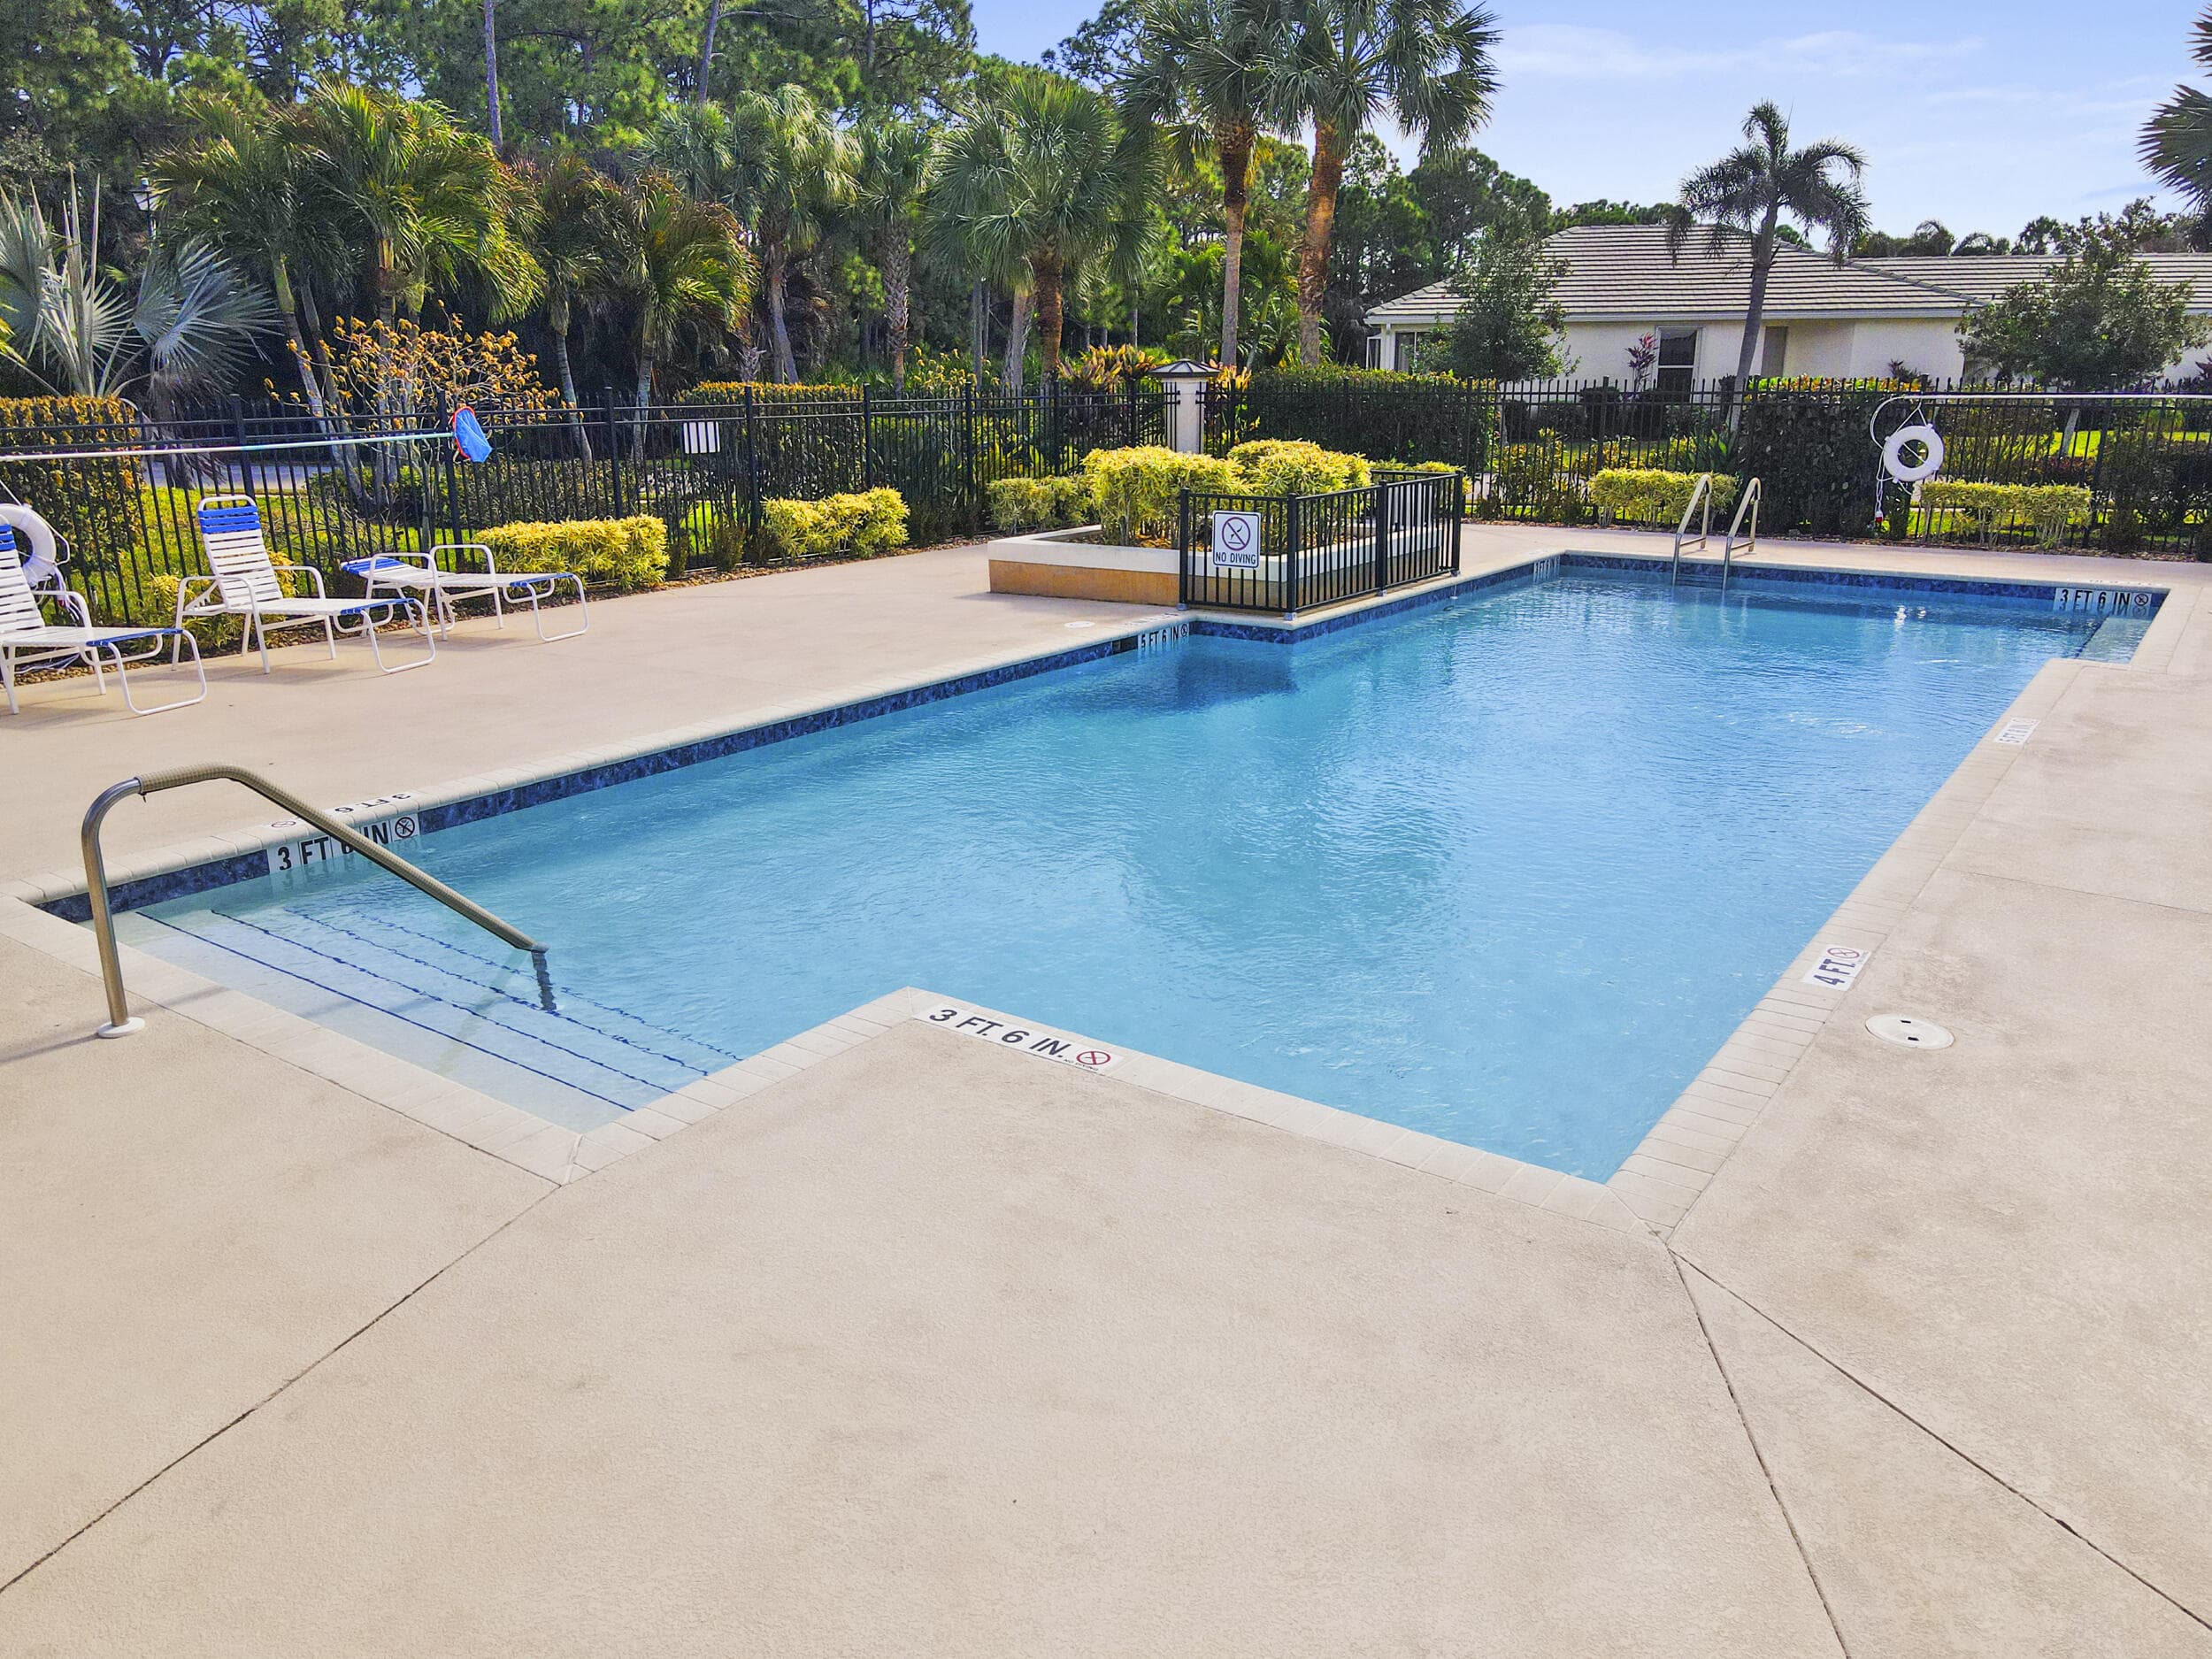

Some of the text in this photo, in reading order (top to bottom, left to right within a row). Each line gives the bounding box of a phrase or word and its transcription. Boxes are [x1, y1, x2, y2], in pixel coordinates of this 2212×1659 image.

[1216, 552, 1256, 565] NO DIVING
[2060, 588, 2131, 605] 3 FT 6 IN
[1141, 626, 1179, 648] 5 FT 6 IN
[277, 846, 292, 871] 3
[300, 836, 329, 864] FT
[1813, 974, 1846, 986] 4
[929, 1009, 1071, 1058] 3 FT. 6 IN.
